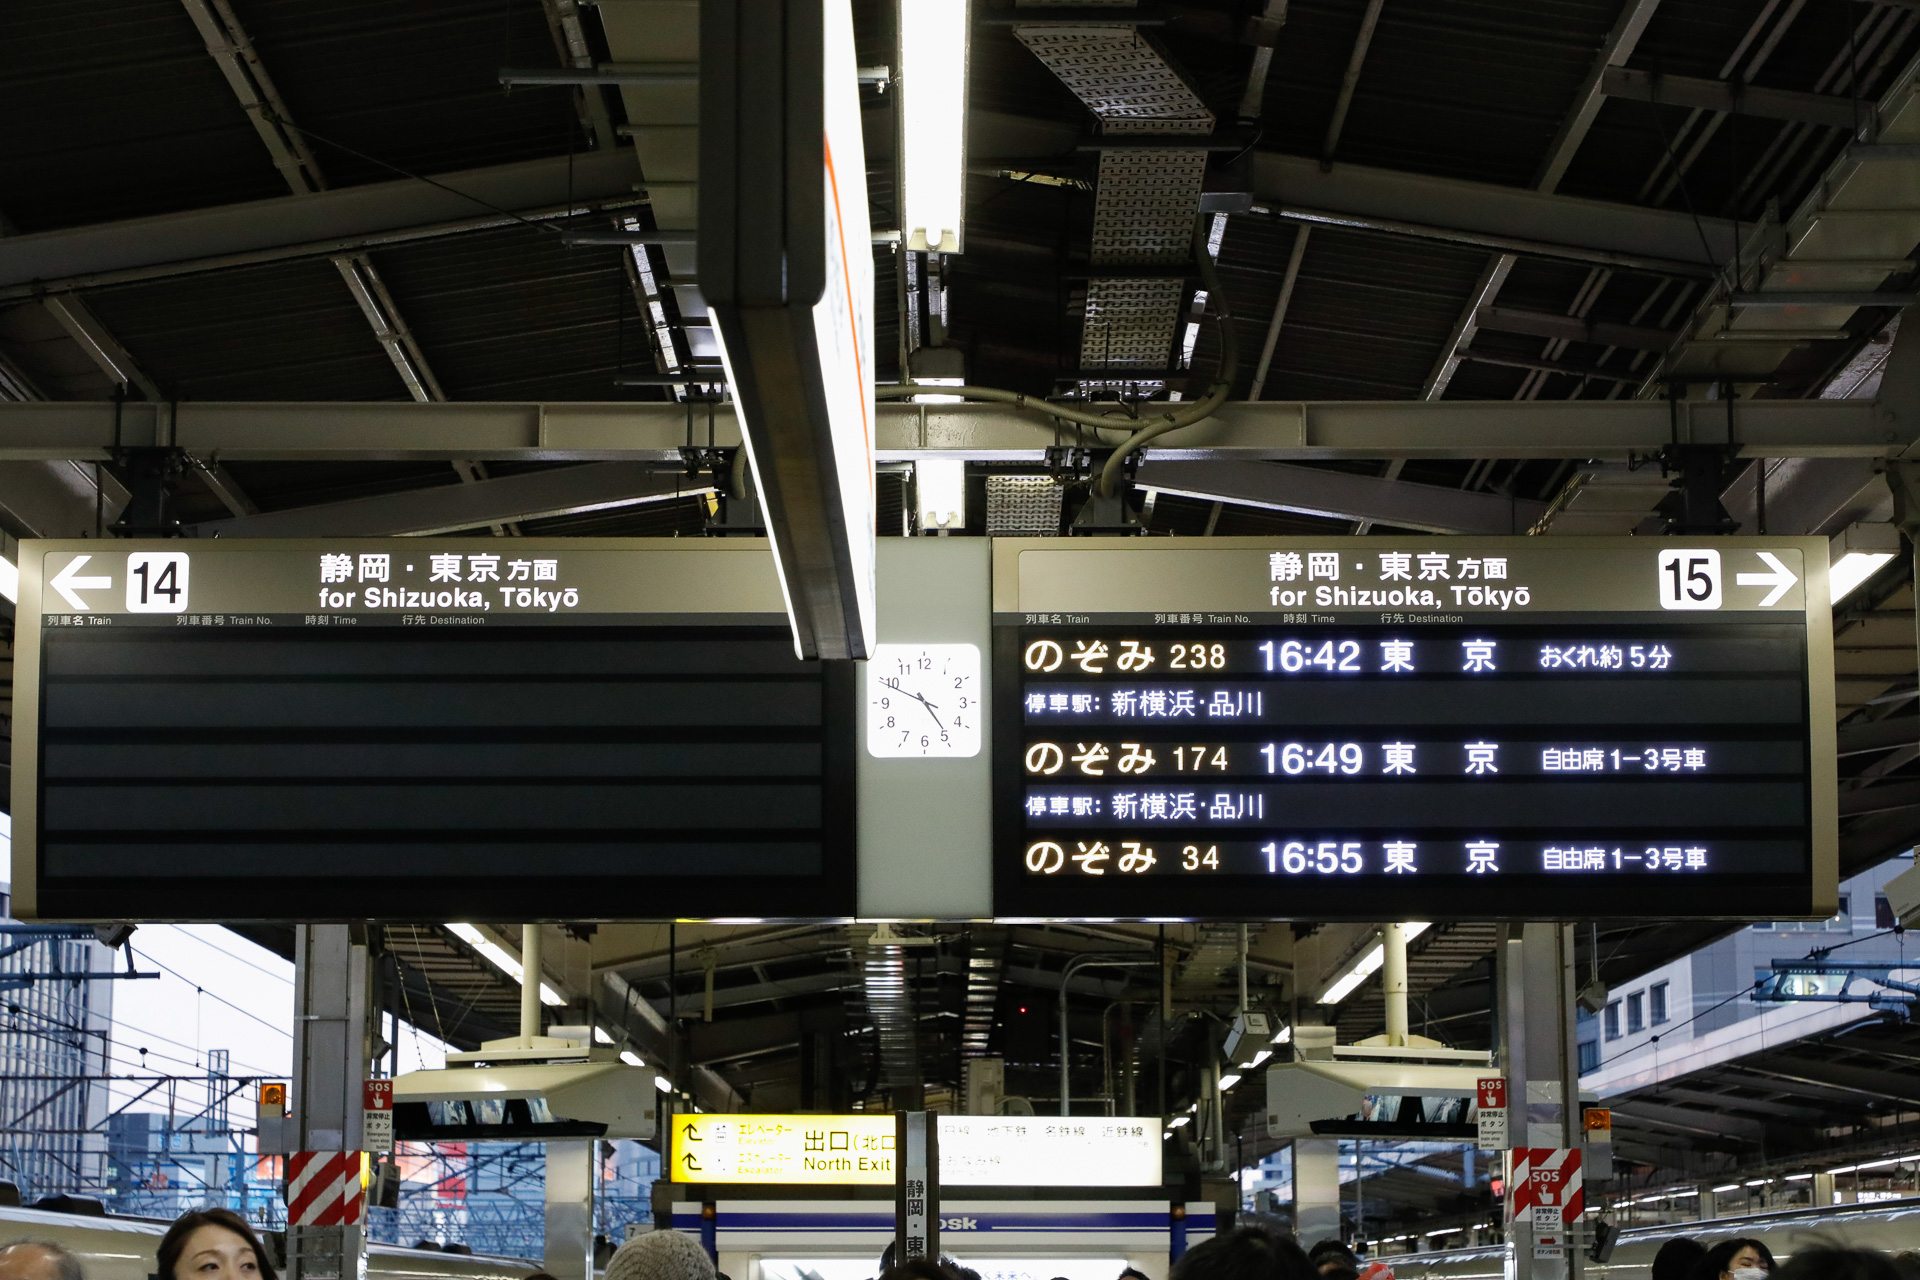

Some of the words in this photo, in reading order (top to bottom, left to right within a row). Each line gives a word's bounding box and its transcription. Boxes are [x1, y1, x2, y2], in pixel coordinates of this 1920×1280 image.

[133, 561, 182, 604] 14
[1664, 557, 1713, 602] 15
[319, 587, 356, 608] for
[363, 587, 491, 612] Shizuoka,
[499, 586, 579, 613] Tōkyō
[1269, 586, 1307, 607] for
[1314, 585, 1443, 610] Shizuoka,
[1450, 585, 1531, 611] Tōkyō
[48, 615, 84, 626] 列車名
[88, 616, 112, 626] Train
[176, 615, 225, 626] 列車番号
[230, 616, 254, 626] Train
[256, 616, 273, 626] No.
[305, 615, 329, 626] 時刻
[333, 616, 357, 625] Time
[402, 615, 426, 626] 行先
[430, 616, 485, 625] Destination
[1025, 613, 1062, 624] 列車名
[1066, 614, 1090, 624] Train
[1154, 613, 1203, 624] 列車番号
[1208, 614, 1232, 624] Train
[1234, 614, 1251, 624] No.
[1283, 613, 1307, 624] 時刻
[1311, 614, 1336, 623] Time
[1380, 613, 1405, 624] 行先
[1408, 614, 1463, 623] Destination
[1025, 640, 1155, 673] のぞみ
[1169, 644, 1226, 669] 238
[1259, 640, 1361, 671] 16:42
[917, 658, 931, 669] 12
[898, 664, 911, 675] 11
[886, 677, 900, 689] 10
[954, 677, 963, 688] 2
[881, 697, 890, 709] 9
[959, 697, 967, 709] 3
[887, 716, 895, 728] 8
[953, 716, 962, 727] 4
[901, 730, 910, 742] 7
[920, 735, 929, 747] 6
[940, 730, 949, 742] 5
[1025, 742, 1156, 775] のぞみ
[1173, 746, 1228, 771] 174
[1260, 743, 1363, 774] 16:49
[1026, 841, 1157, 874] のぞみ
[1182, 845, 1219, 870] 34
[1261, 842, 1364, 873] 16:55
[368, 1083, 390, 1091] SOS
[1480, 1081, 1502, 1089] SOS
[1480, 1120, 1504, 1128] ボタン
[804, 1157, 851, 1171] North
[858, 1157, 891, 1171] Exit
[1532, 1171, 1560, 1182] SOS
[629, 1227, 636, 1237] 7
